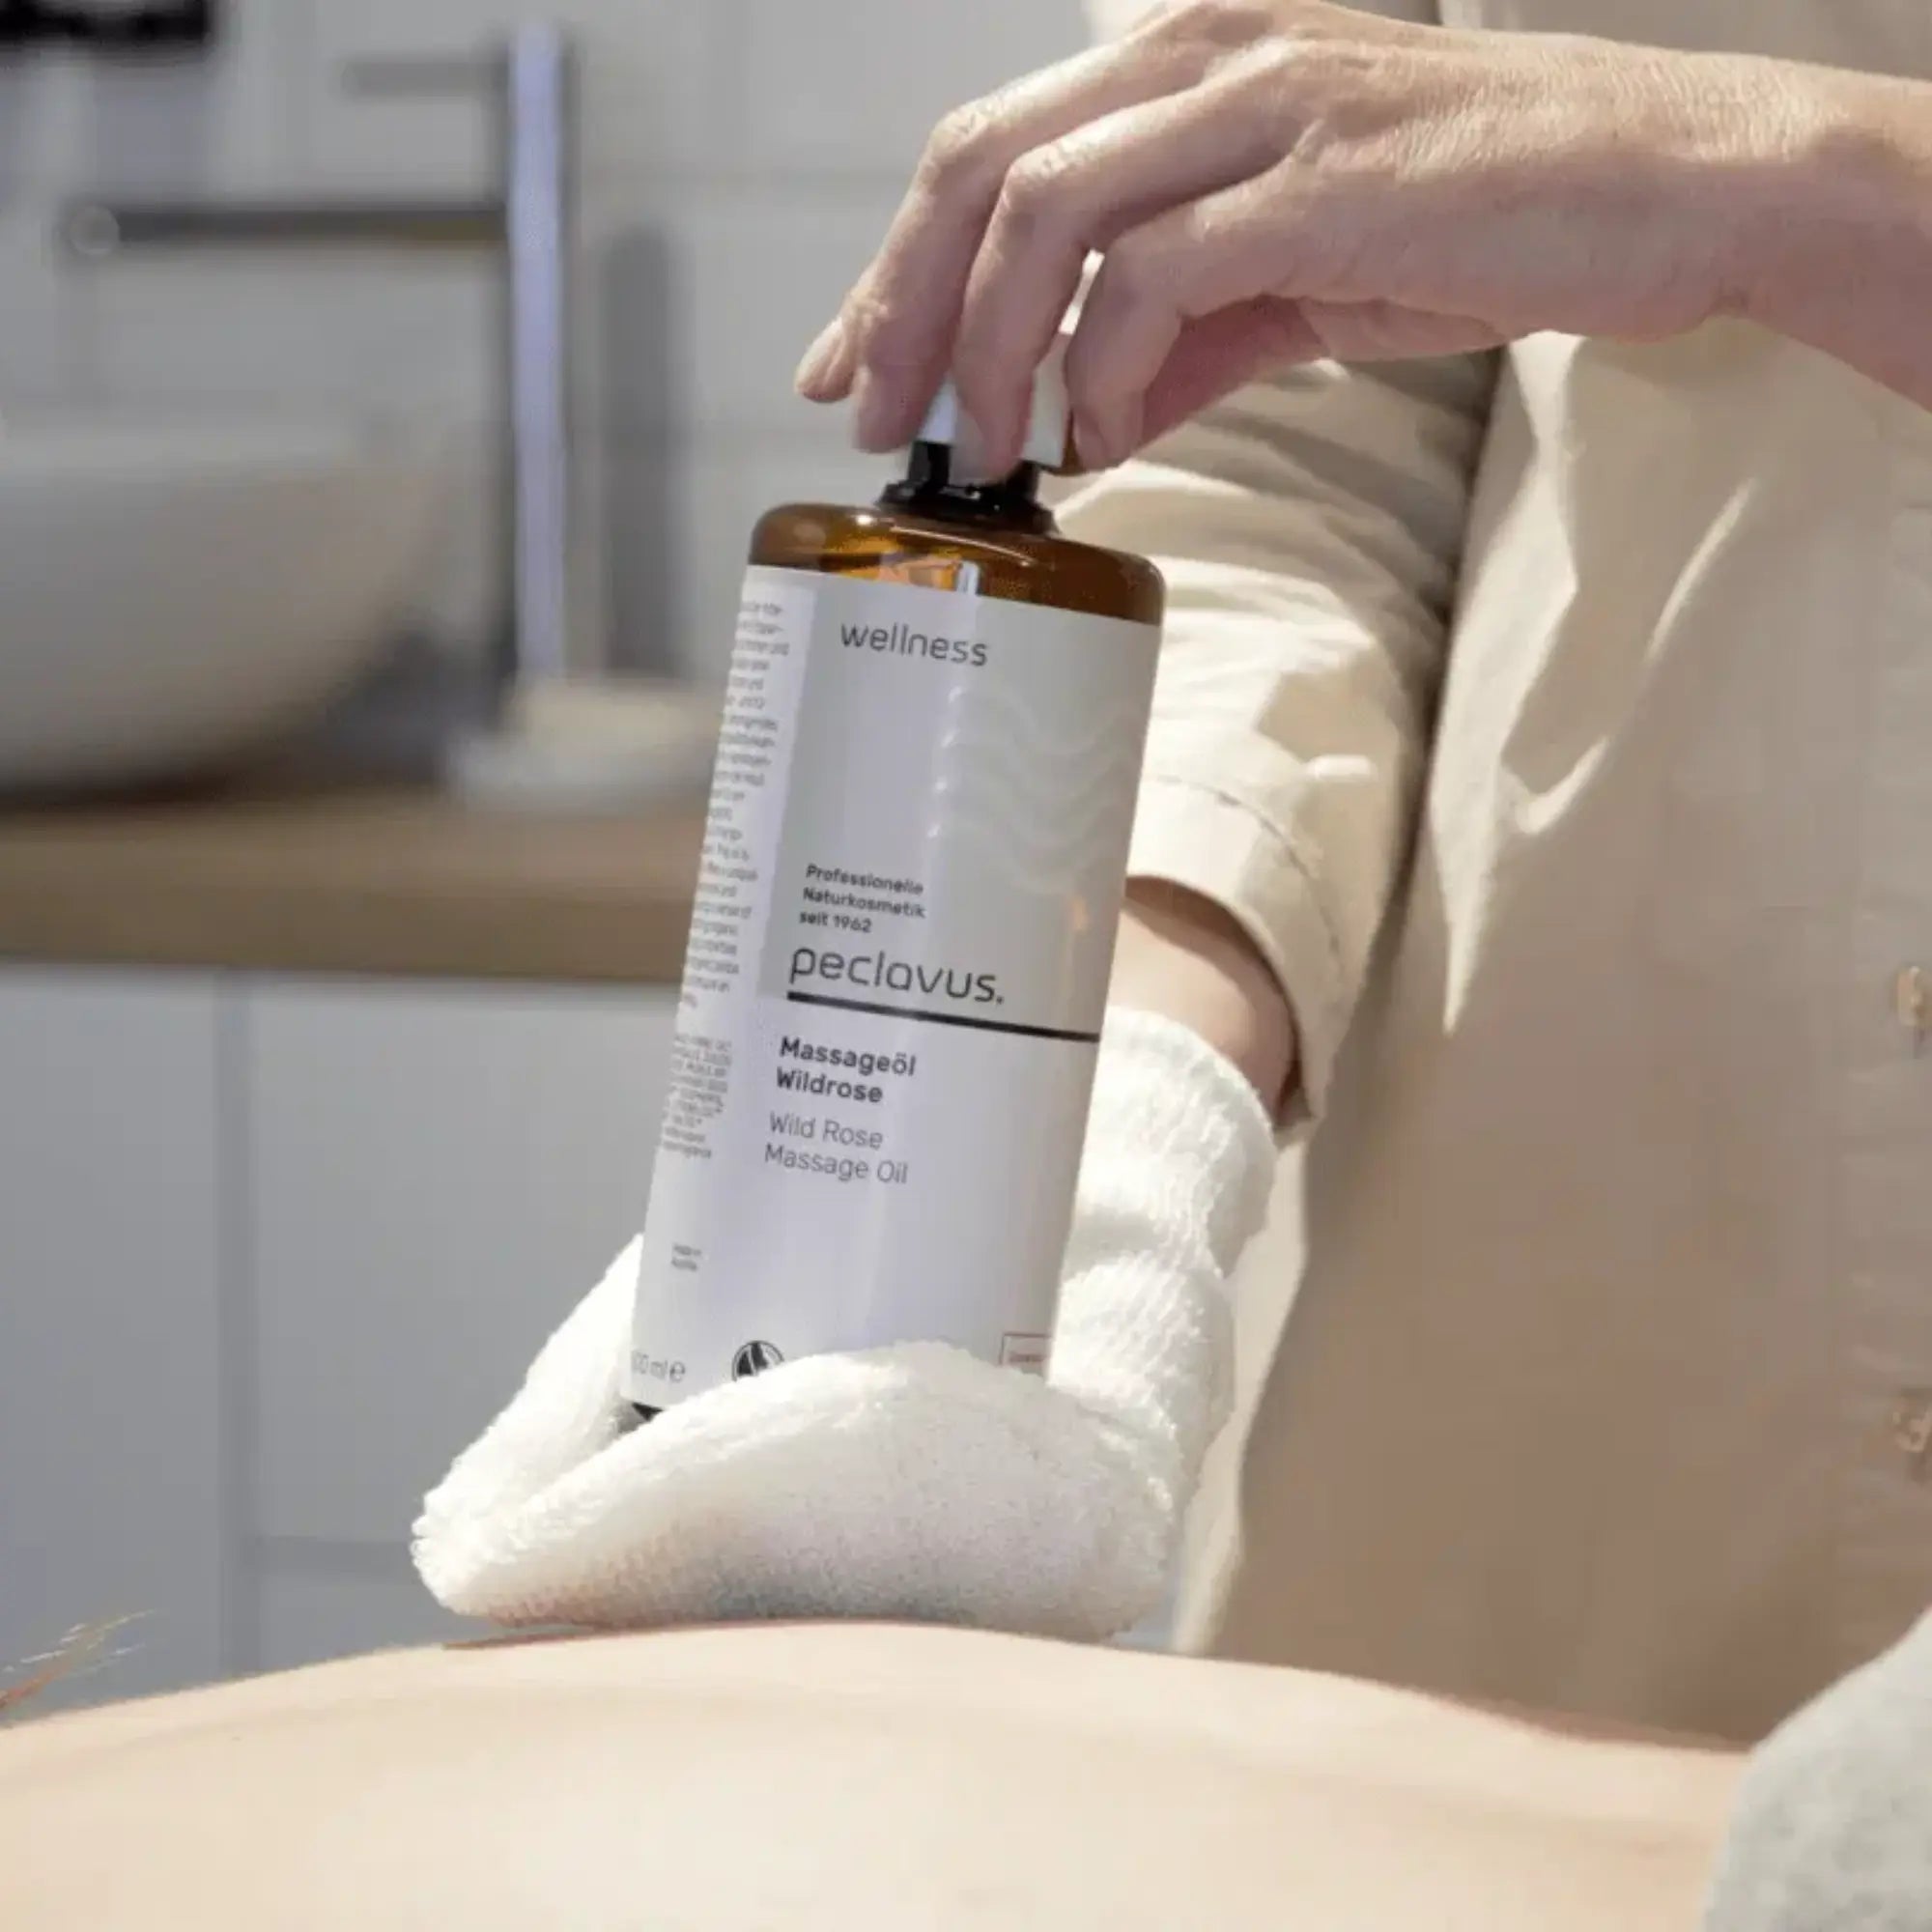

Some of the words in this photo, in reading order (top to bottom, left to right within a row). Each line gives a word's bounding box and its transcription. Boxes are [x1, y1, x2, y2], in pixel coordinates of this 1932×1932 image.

[839, 621, 989, 667] wellness
[805, 863, 924, 896] Professionelle
[799, 909, 829, 928] seit
[833, 912, 872, 933] 1962
[802, 886, 926, 919] Naturkosmetik
[788, 947, 1005, 1005] peclavus.
[778, 1036, 917, 1077] Massageöl
[775, 1065, 884, 1103] Wildrose
[769, 1111, 816, 1140] Wild
[822, 1119, 884, 1151] Rose
[764, 1143, 869, 1182] Massage
[876, 1159, 909, 1184] Oil
